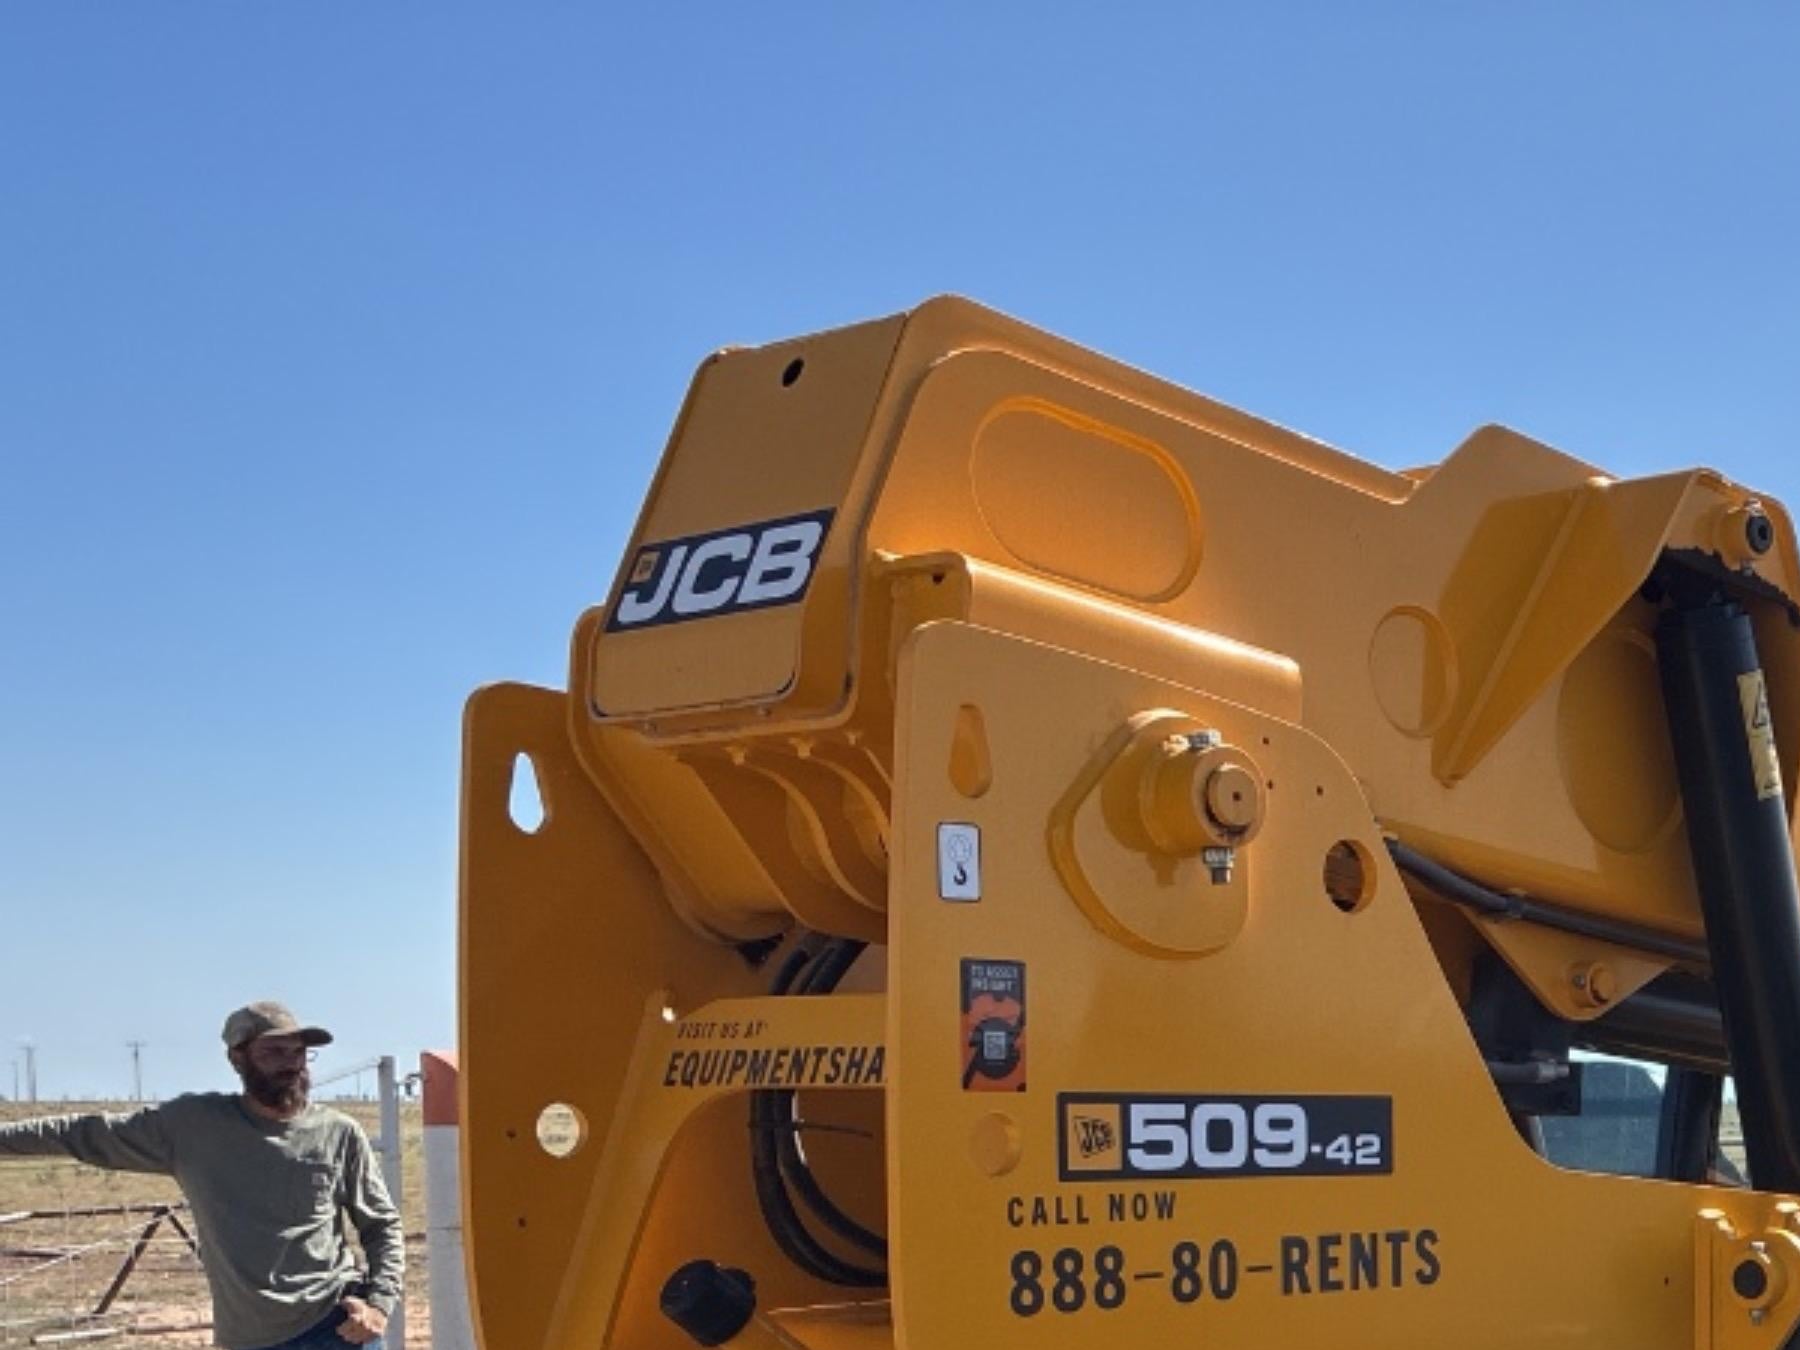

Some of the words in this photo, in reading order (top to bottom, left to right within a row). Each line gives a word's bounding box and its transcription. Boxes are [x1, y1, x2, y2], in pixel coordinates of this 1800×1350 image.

[616, 519, 823, 623] JCB
[720, 1022, 739, 1039] US
[662, 1046, 887, 1089] EQUIPMENTSHA
[1007, 1195, 1090, 1228] CALL
[1108, 1191, 1176, 1222] NOW
[1009, 1228, 1441, 1318] 888-80-RENTS
